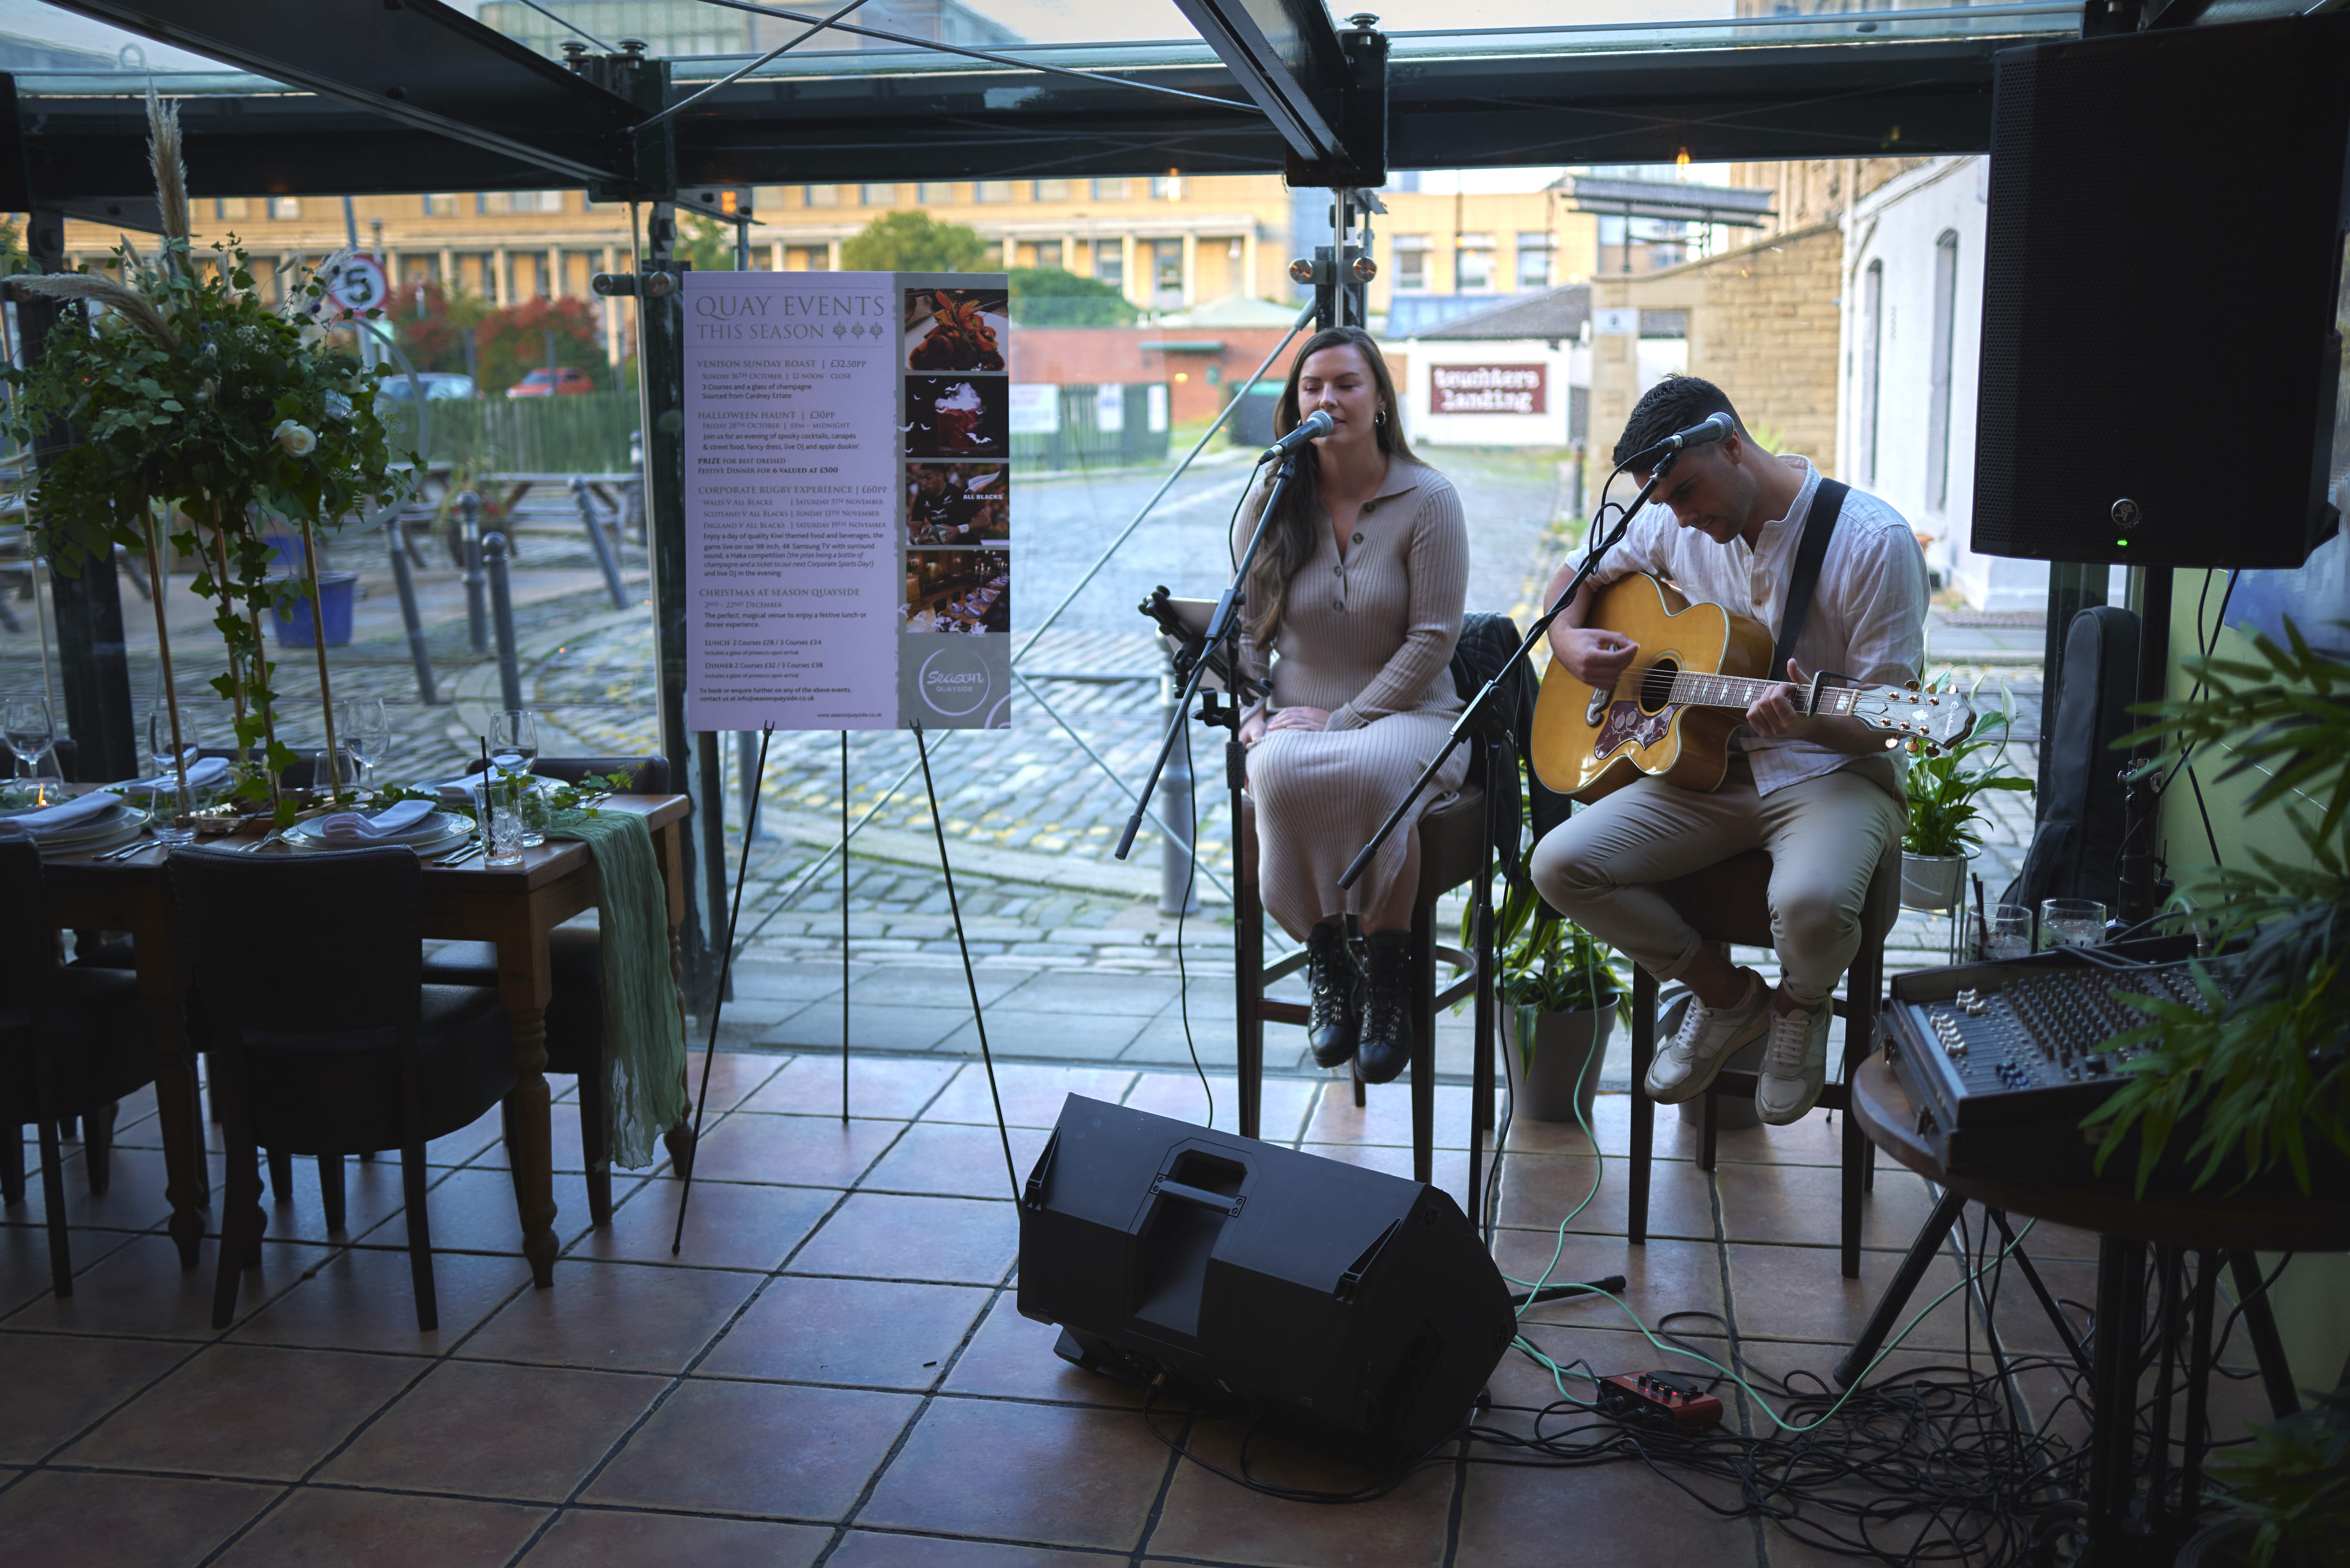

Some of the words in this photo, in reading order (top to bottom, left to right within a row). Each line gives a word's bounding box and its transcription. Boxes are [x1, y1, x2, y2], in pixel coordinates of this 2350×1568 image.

[345, 266, 372, 302] 5
[696, 296, 772, 320] QUAY
[784, 296, 884, 316] EVENTS
[696, 324, 742, 339] THIS
[750, 324, 823, 339] SEASON
[811, 588, 860, 598] QUAYSIDE
[926, 671, 984, 684] Season
[1944, 700, 1959, 737] Epiphone
